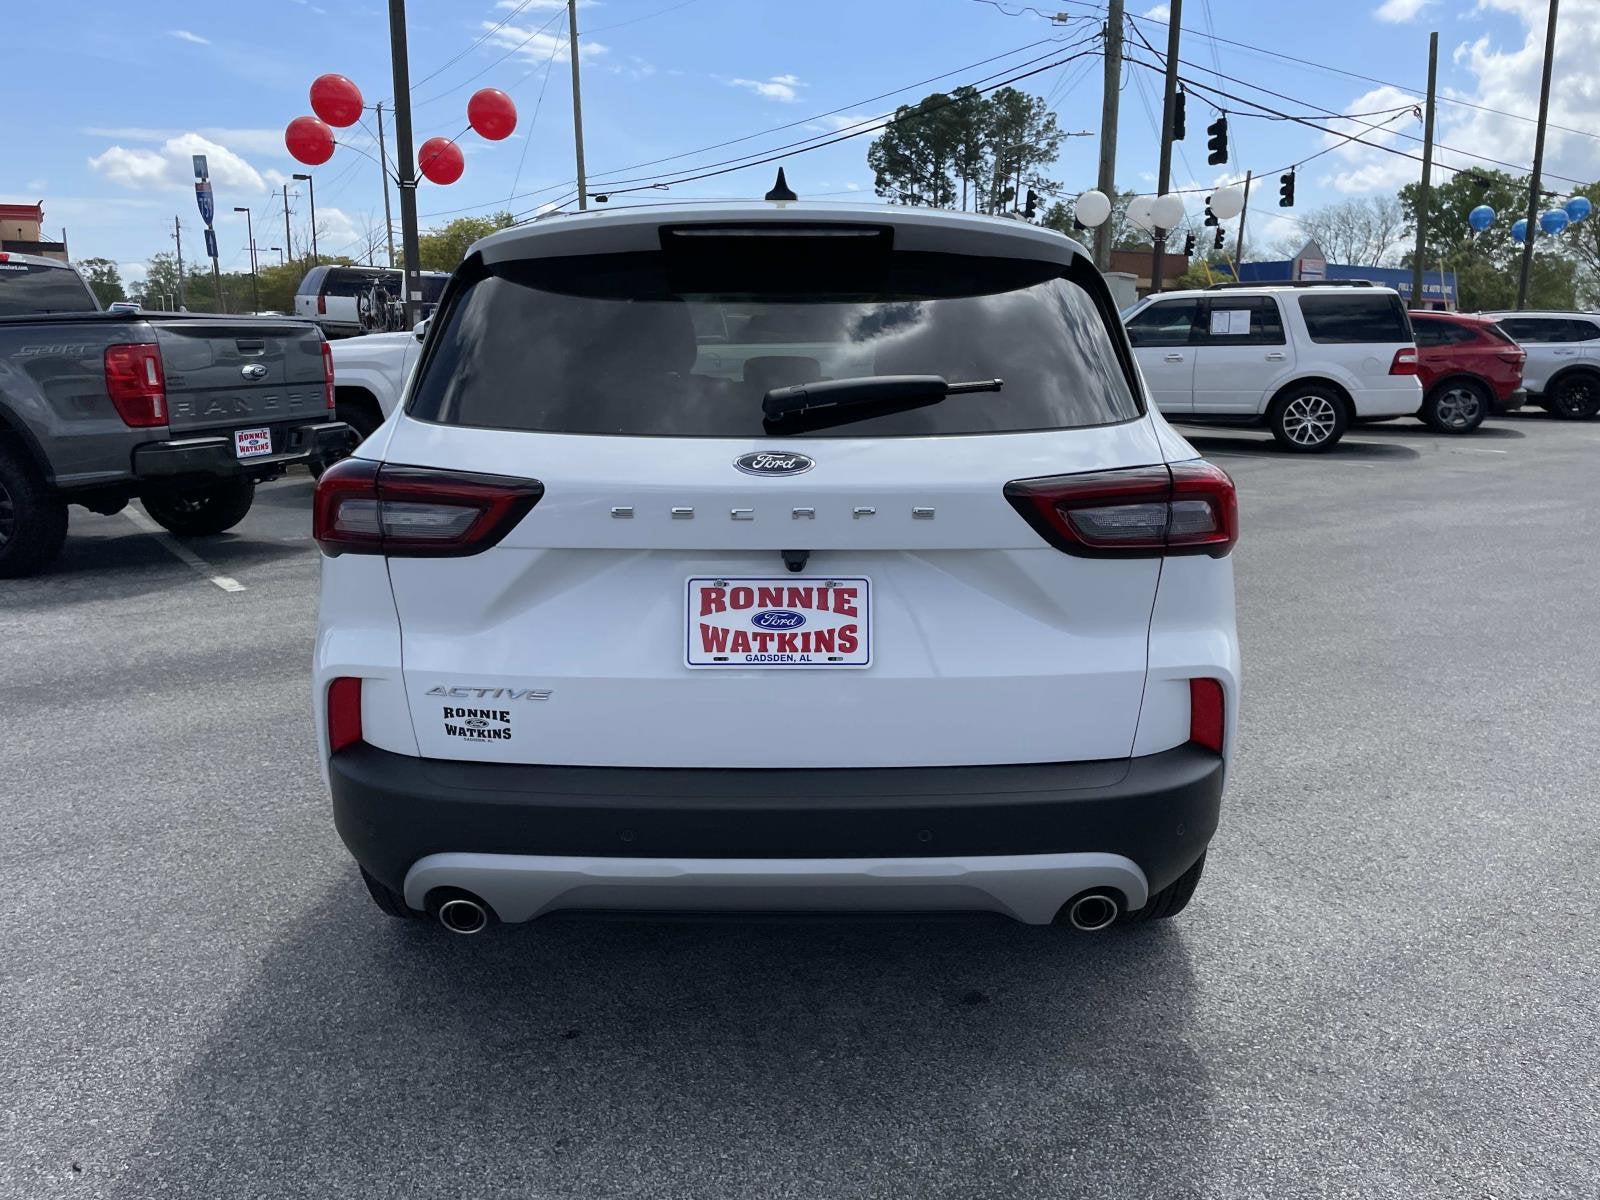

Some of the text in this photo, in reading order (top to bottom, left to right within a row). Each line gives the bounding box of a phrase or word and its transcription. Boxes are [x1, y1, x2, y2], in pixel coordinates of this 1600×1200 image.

[238, 431, 268, 443] RONNIE
[239, 442, 269, 453] WATKINS
[752, 454, 795, 470] Ford
[610, 506, 936, 520] ESCAPE
[700, 587, 858, 618] RONNIE
[760, 612, 798, 627] Ford
[700, 622, 859, 653] WATKINS
[745, 654, 813, 663] GADSDEN, AL
[425, 686, 553, 701] ACTIVE
[443, 706, 511, 724] RONNIE
[444, 723, 512, 740] WATKINS
